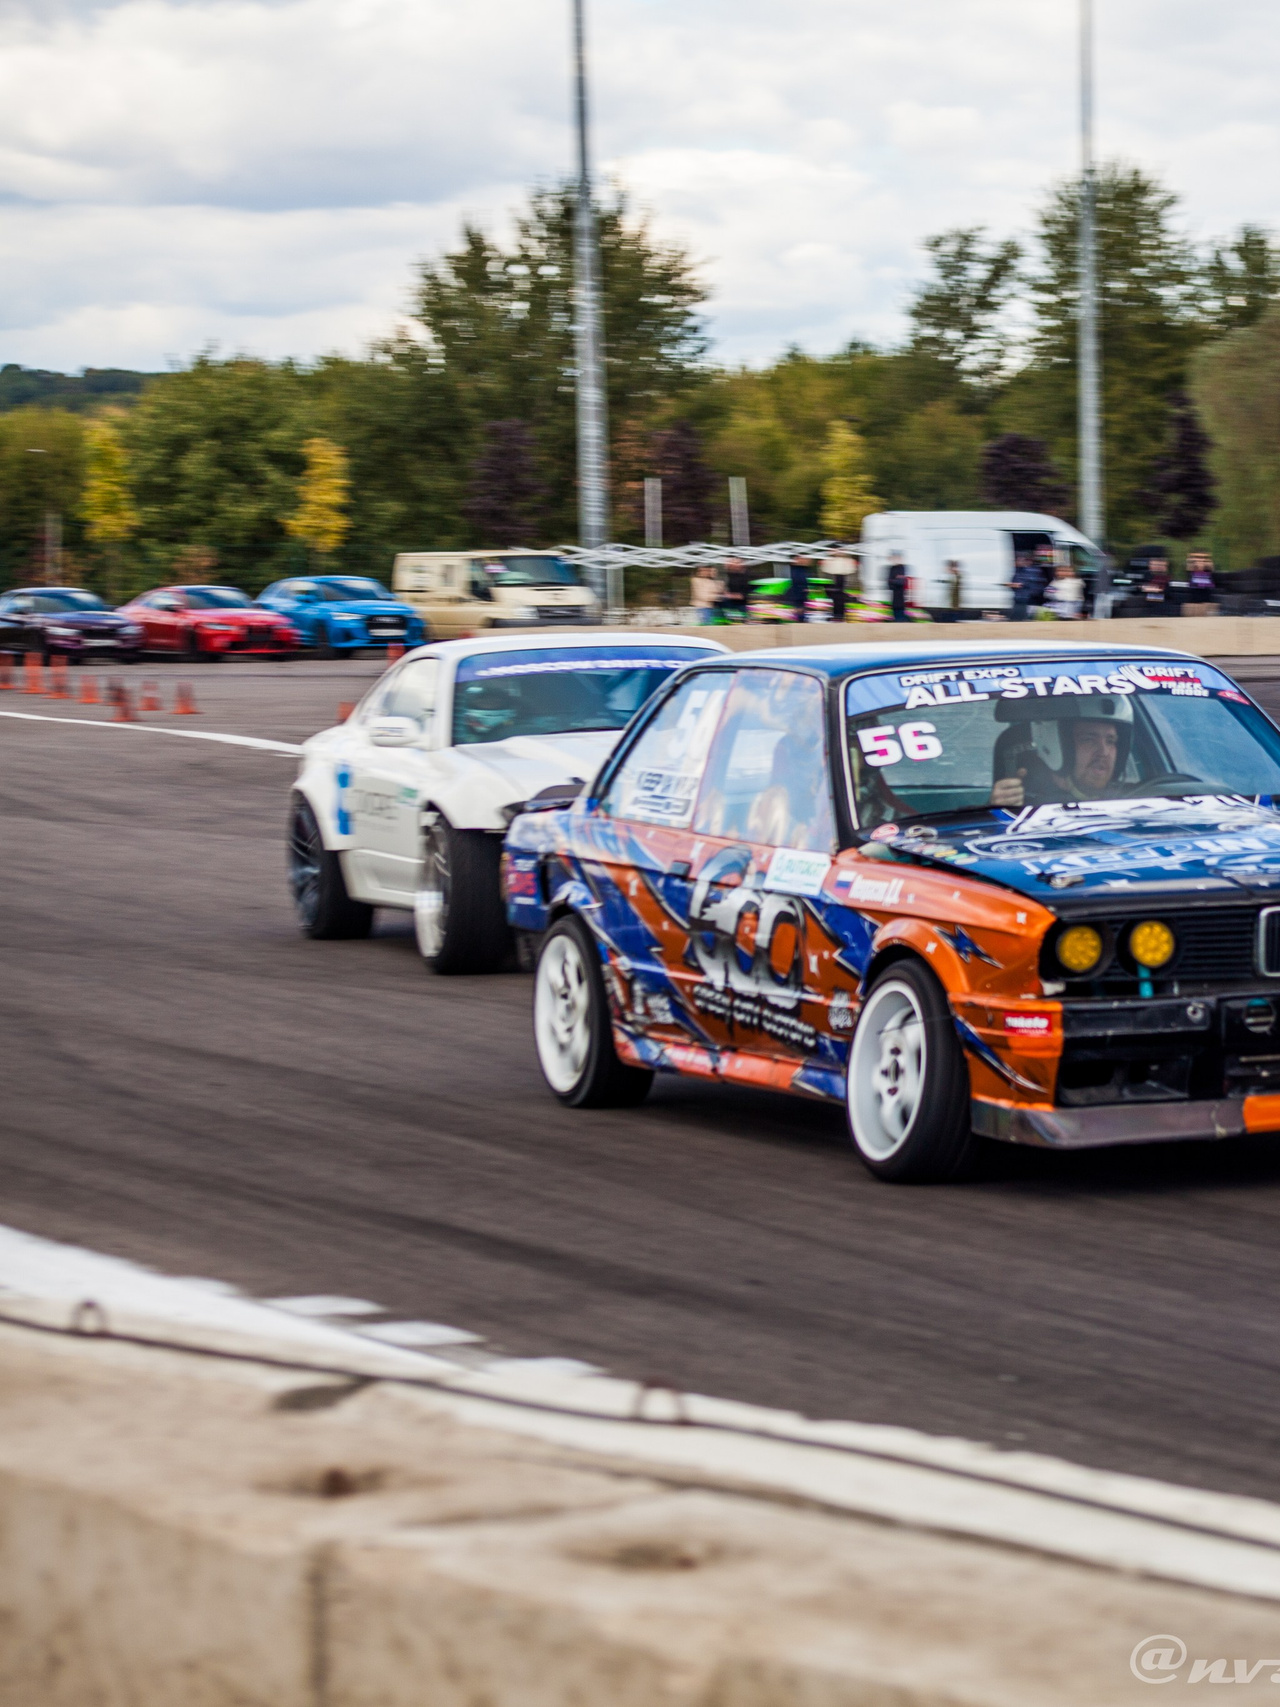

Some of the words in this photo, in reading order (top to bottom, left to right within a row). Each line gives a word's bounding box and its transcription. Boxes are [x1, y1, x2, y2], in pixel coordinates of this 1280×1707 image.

[900, 670, 960, 687] DRIFT
[963, 667, 1020, 681] EXPO
[1142, 665, 1196, 679] DRIFT
[905, 681, 990, 710] ALL
[999, 674, 1136, 699] STARS
[1160, 681, 1204, 690] TRACK
[857, 720, 944, 767] 56
